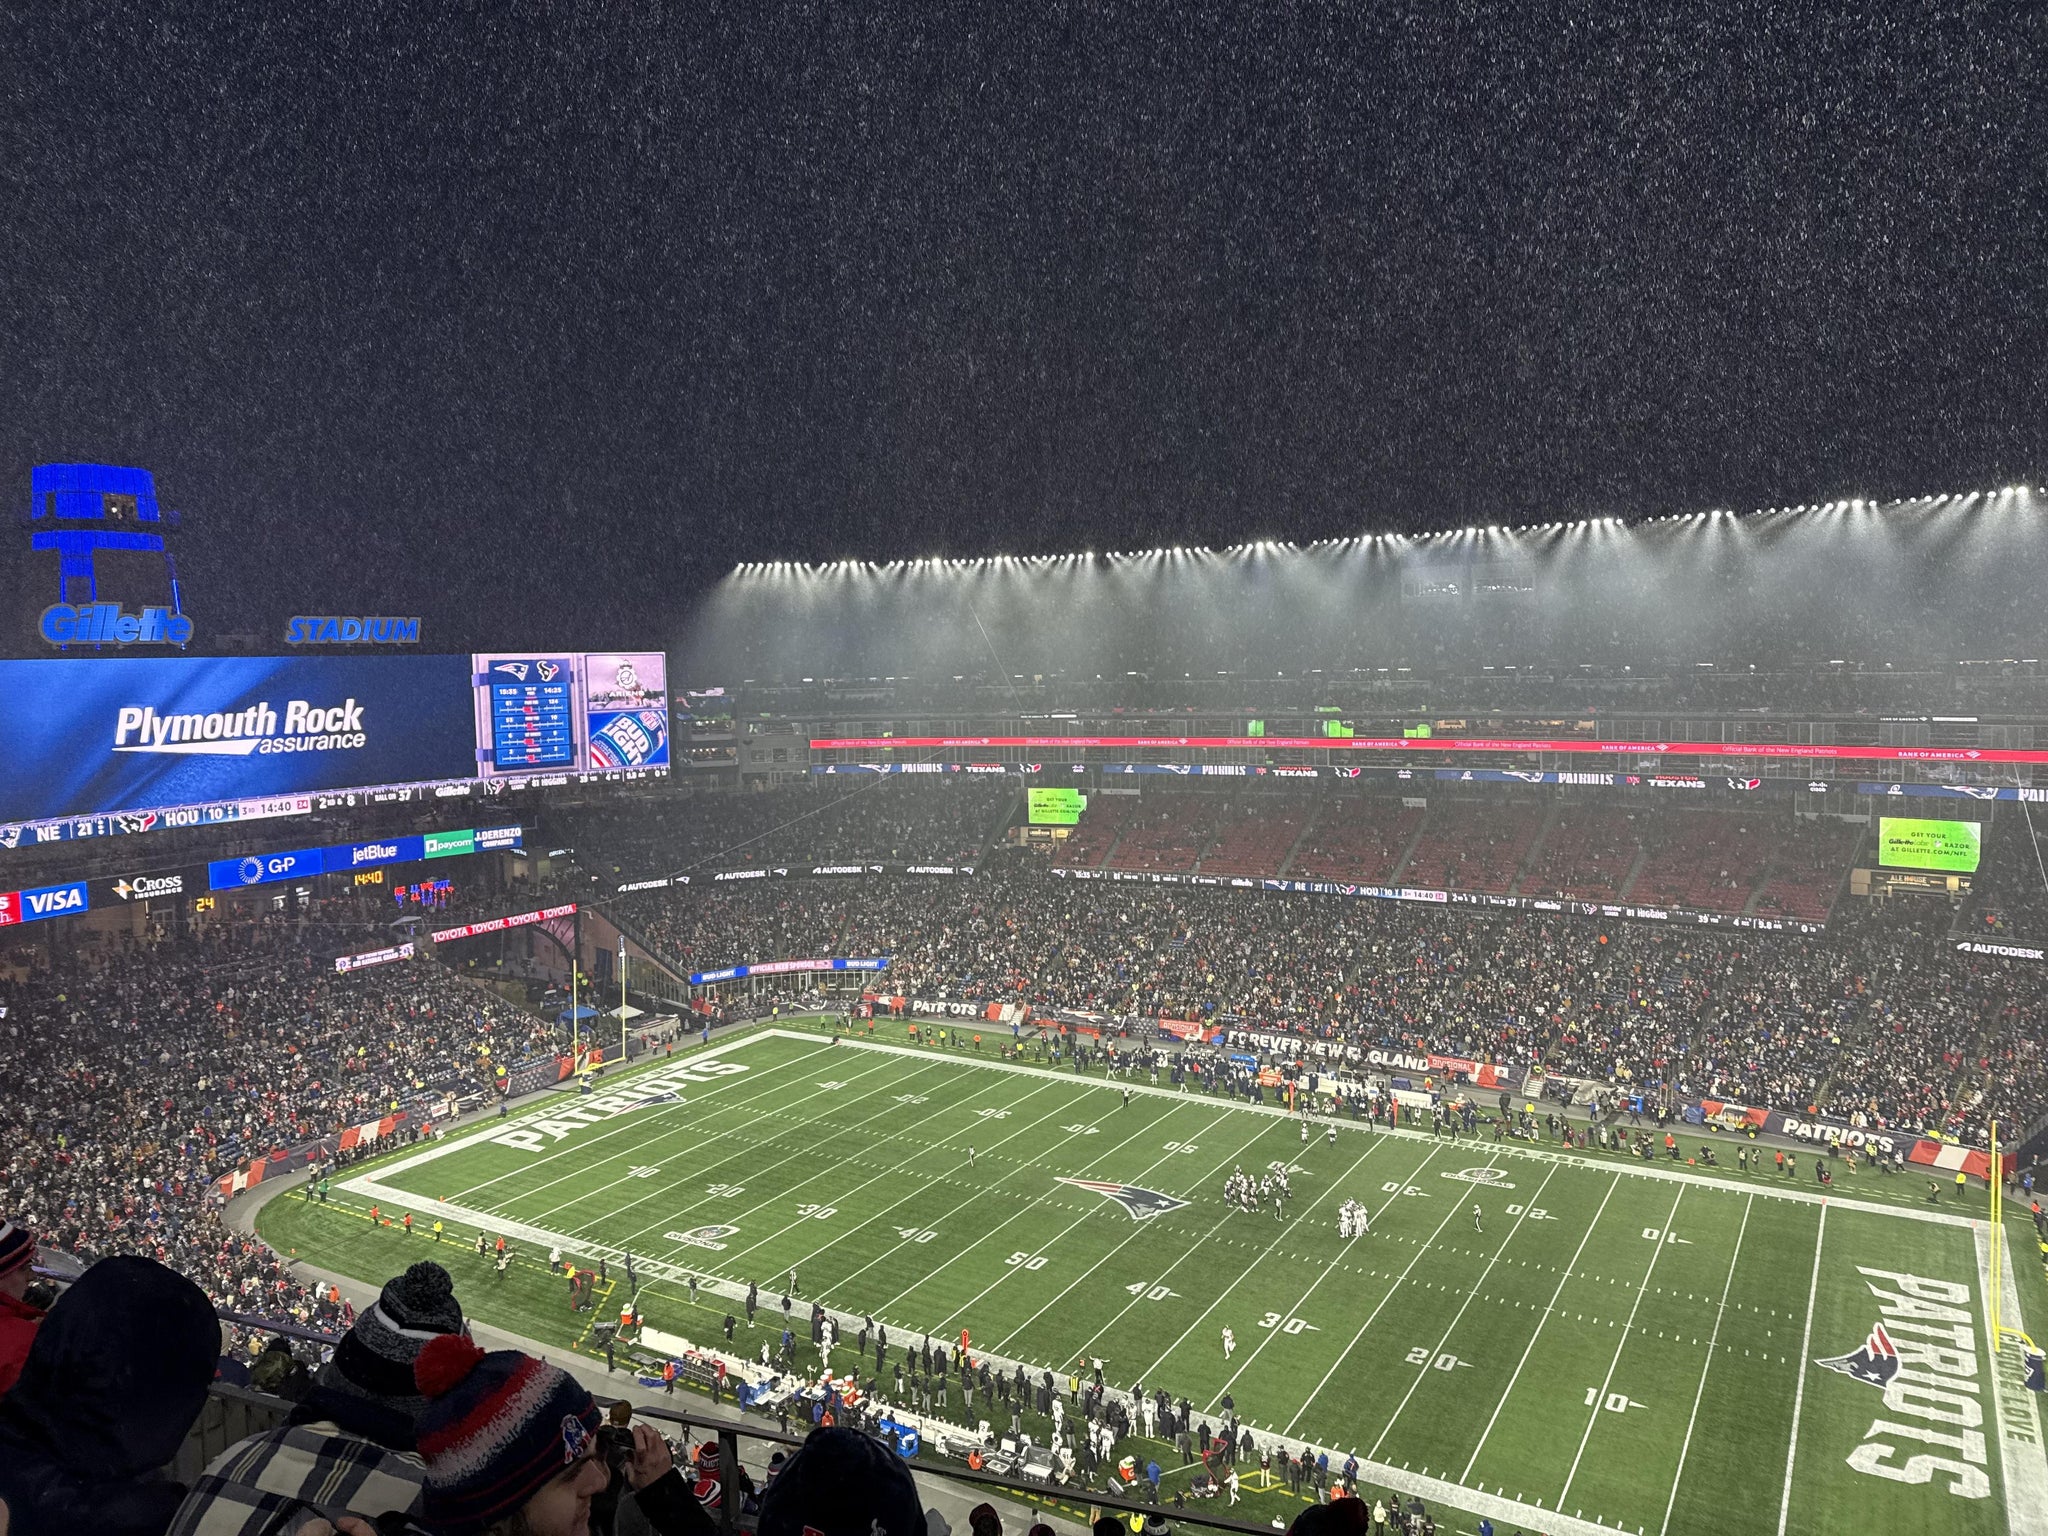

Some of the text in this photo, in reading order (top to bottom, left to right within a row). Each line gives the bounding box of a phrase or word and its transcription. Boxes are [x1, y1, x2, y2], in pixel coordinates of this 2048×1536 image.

[39, 603, 193, 643] Gillette
[286, 615, 422, 644] STADIUM
[115, 698, 364, 746] Plymouth Rock
[259, 732, 366, 755] assurance
[615, 717, 649, 753] BUD
[601, 723, 643, 766] LIGHT
[1790, 747, 1813, 755] England
[1272, 769, 1319, 777] TEXANS
[1647, 778, 1706, 788] TEXANS
[37, 826, 61, 842] NE
[77, 822, 93, 837] 21
[165, 810, 199, 827] HOU
[208, 808, 223, 820] 10
[261, 801, 291, 814] 14:40
[347, 795, 356, 806] 8
[398, 789, 411, 801] 37
[474, 827, 522, 842] J.DERENZO
[352, 844, 398, 865] jetBlue
[438, 840, 473, 851] paycom
[354, 870, 383, 886] 14:40
[724, 869, 766, 881] AUTODESK
[822, 865, 862, 875] AUTODESK
[915, 866, 953, 875] AUTODESK
[1890, 874, 1903, 882] ALE
[1904, 875, 1927, 883] HOUSE
[627, 878, 668, 891] AUTODESK
[1360, 886, 1379, 896] HOU
[25, 888, 83, 914] VISA
[195, 897, 214, 912] 24
[1637, 908, 1668, 919] HIGGINS
[431, 904, 574, 943] TOYOTA TOYOTA TOYOTA TOYOTA
[1971, 942, 2045, 960] AUTODESK
[860, 960, 878, 968] LIGHT
[702, 970, 735, 981] BUD LIGHT
[912, 1000, 978, 1016] PATROTS
[1346, 1046, 1430, 1071] EGLAND
[490, 1059, 751, 1153] PATRIOTS
[1782, 1117, 1894, 1154] PATRIOTS
[630, 1166, 661, 1178] 10
[706, 1183, 745, 1198] 20
[797, 1204, 838, 1219] 30
[898, 1226, 938, 1244] 40
[1004, 1251, 1049, 1270] 50
[1125, 1281, 1171, 1301] 40
[1257, 1311, 1308, 1335] 30
[1404, 1347, 1458, 1371] 20
[1844, 1264, 1991, 1499] PATRIOTS
[1584, 1386, 1629, 1413] 10
[2001, 1395, 2037, 1445] LOVE
